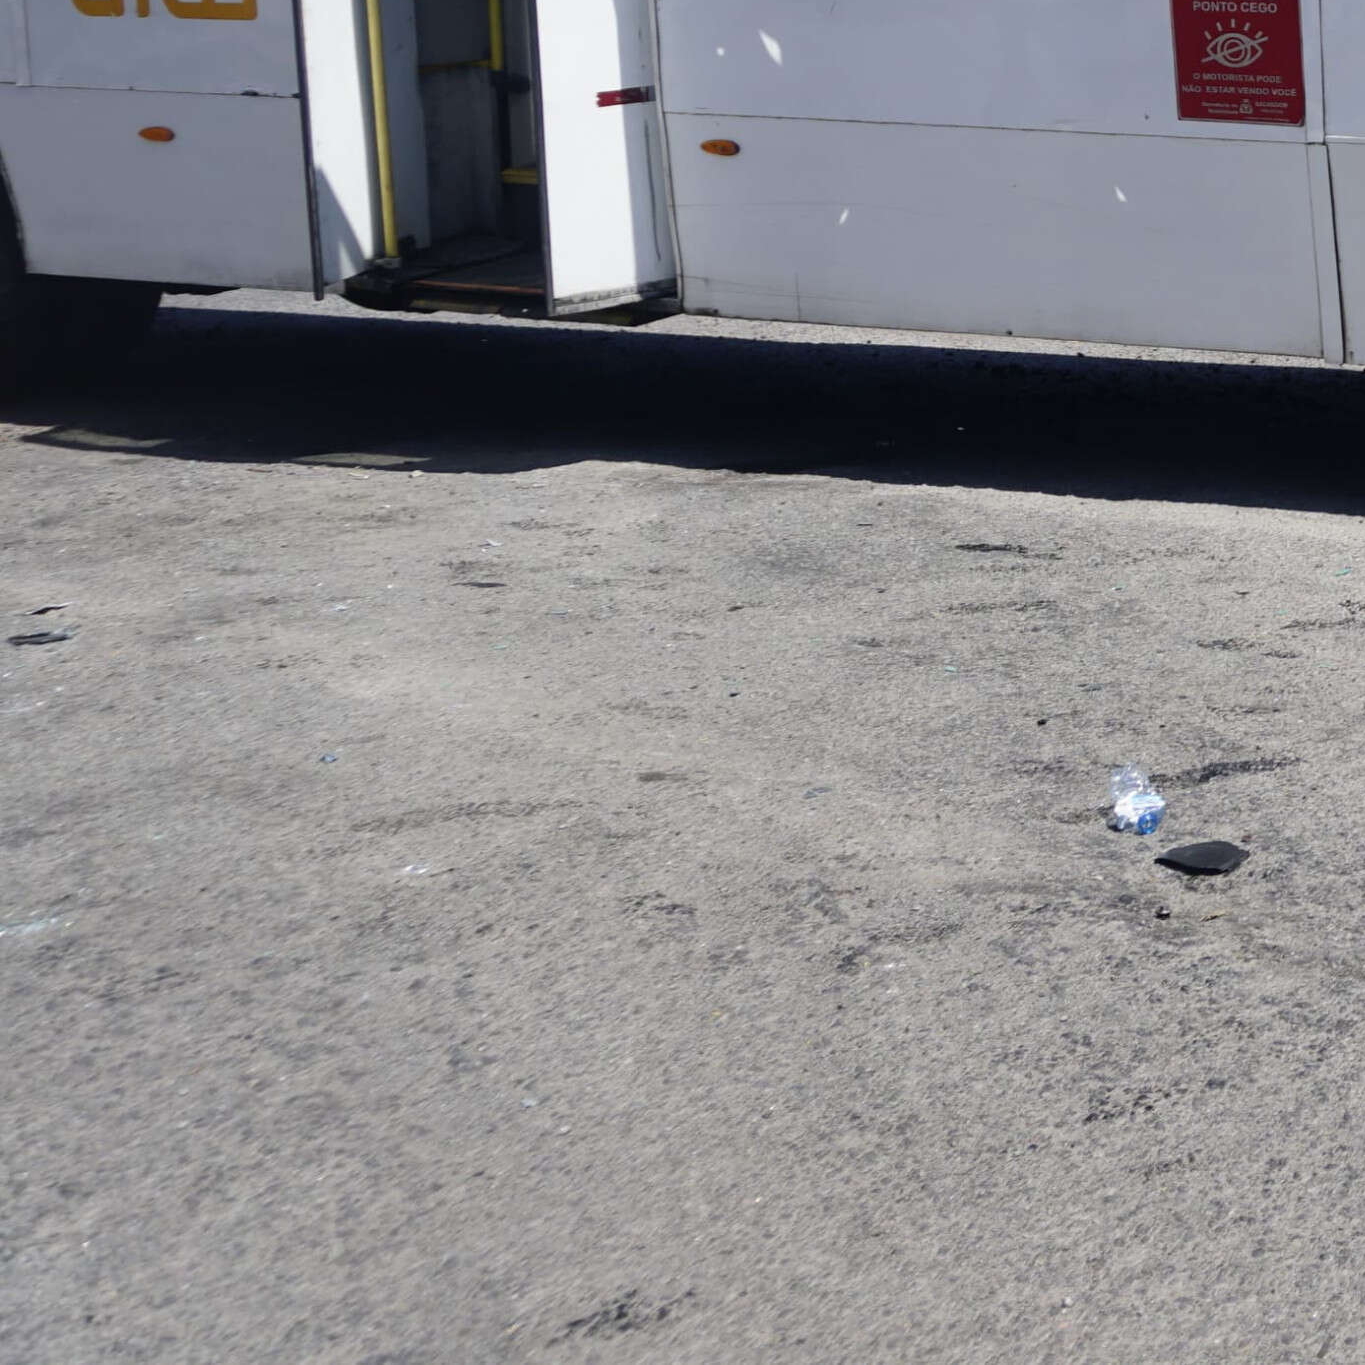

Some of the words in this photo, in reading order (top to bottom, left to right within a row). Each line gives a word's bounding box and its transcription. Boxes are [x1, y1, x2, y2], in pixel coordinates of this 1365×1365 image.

[1192, 0, 1238, 12] PONTO
[1240, 2, 1278, 13] CEGO
[1192, 73, 1201, 81] O
[1202, 73, 1255, 83] MOTORISTA
[1256, 75, 1282, 84] PODE
[1182, 83, 1202, 93] NÃO
[1206, 85, 1236, 94] ESTAR
[1238, 87, 1270, 96] VENDO
[1271, 86, 1297, 97] VOCÊ
